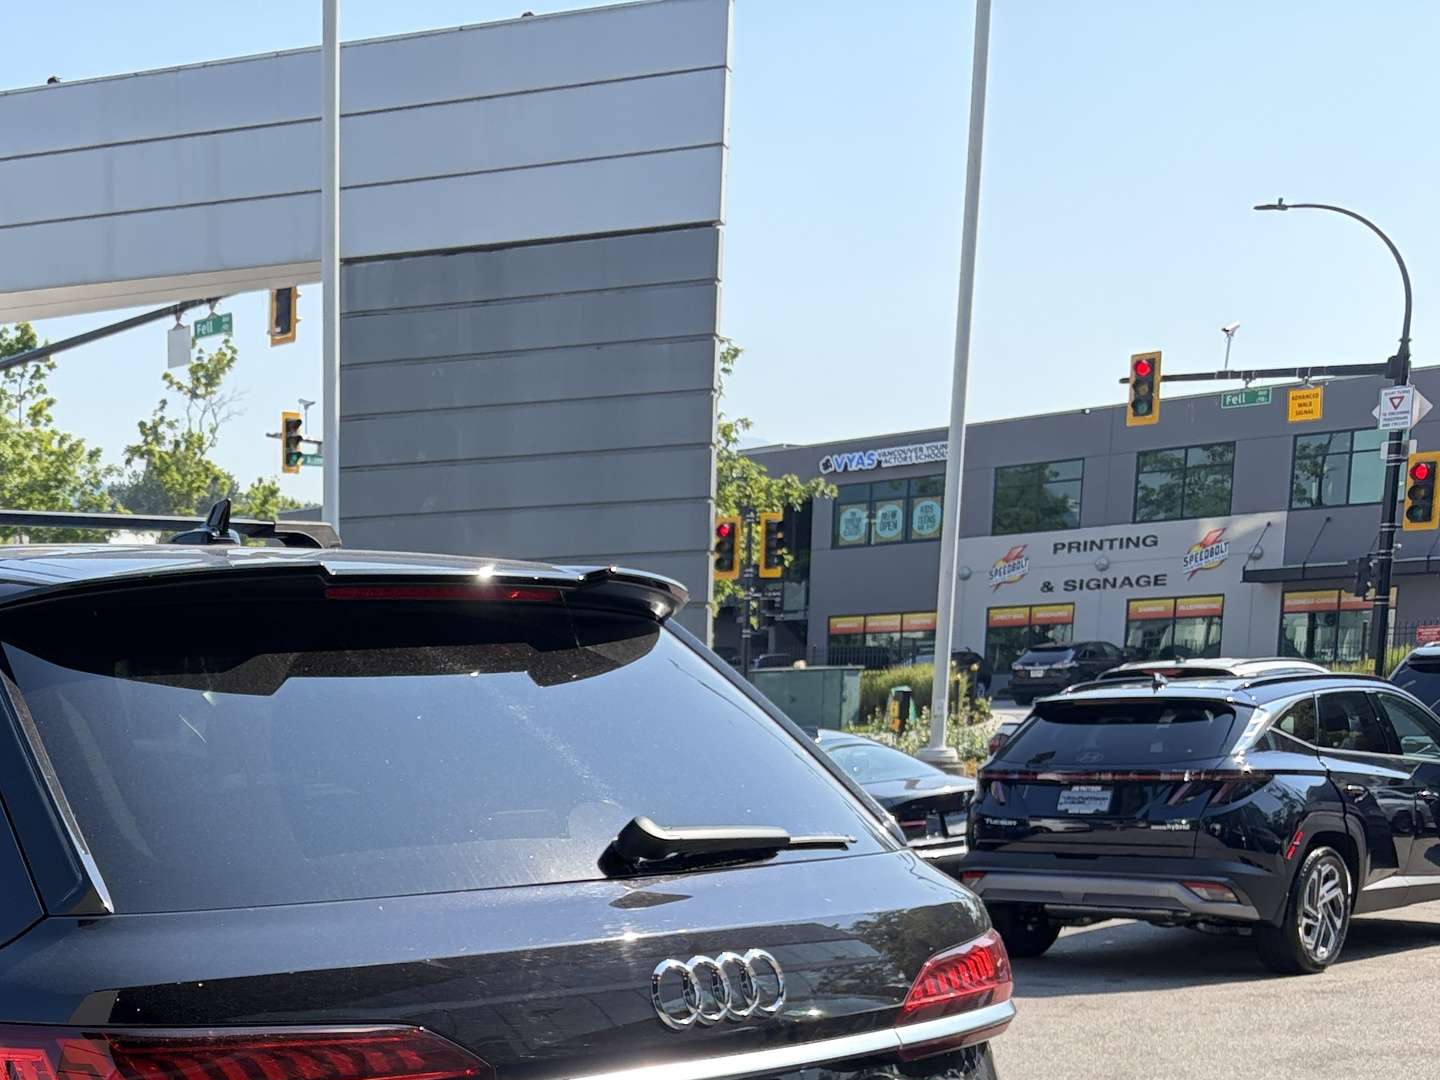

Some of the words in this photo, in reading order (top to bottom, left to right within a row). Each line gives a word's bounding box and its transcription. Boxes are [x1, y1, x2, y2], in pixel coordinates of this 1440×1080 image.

[196, 322, 213, 334] Fell
[1225, 393, 1246, 406] Fell
[924, 442, 949, 452] YOUN
[833, 451, 877, 472] VYAS
[1052, 534, 1159, 555] PRINTING
[1183, 541, 1229, 568] SPEEDBOLT
[988, 556, 1030, 581] SPEEDBOLT
[1040, 581, 1054, 593] &
[1063, 574, 1168, 592] SIGNAGE
